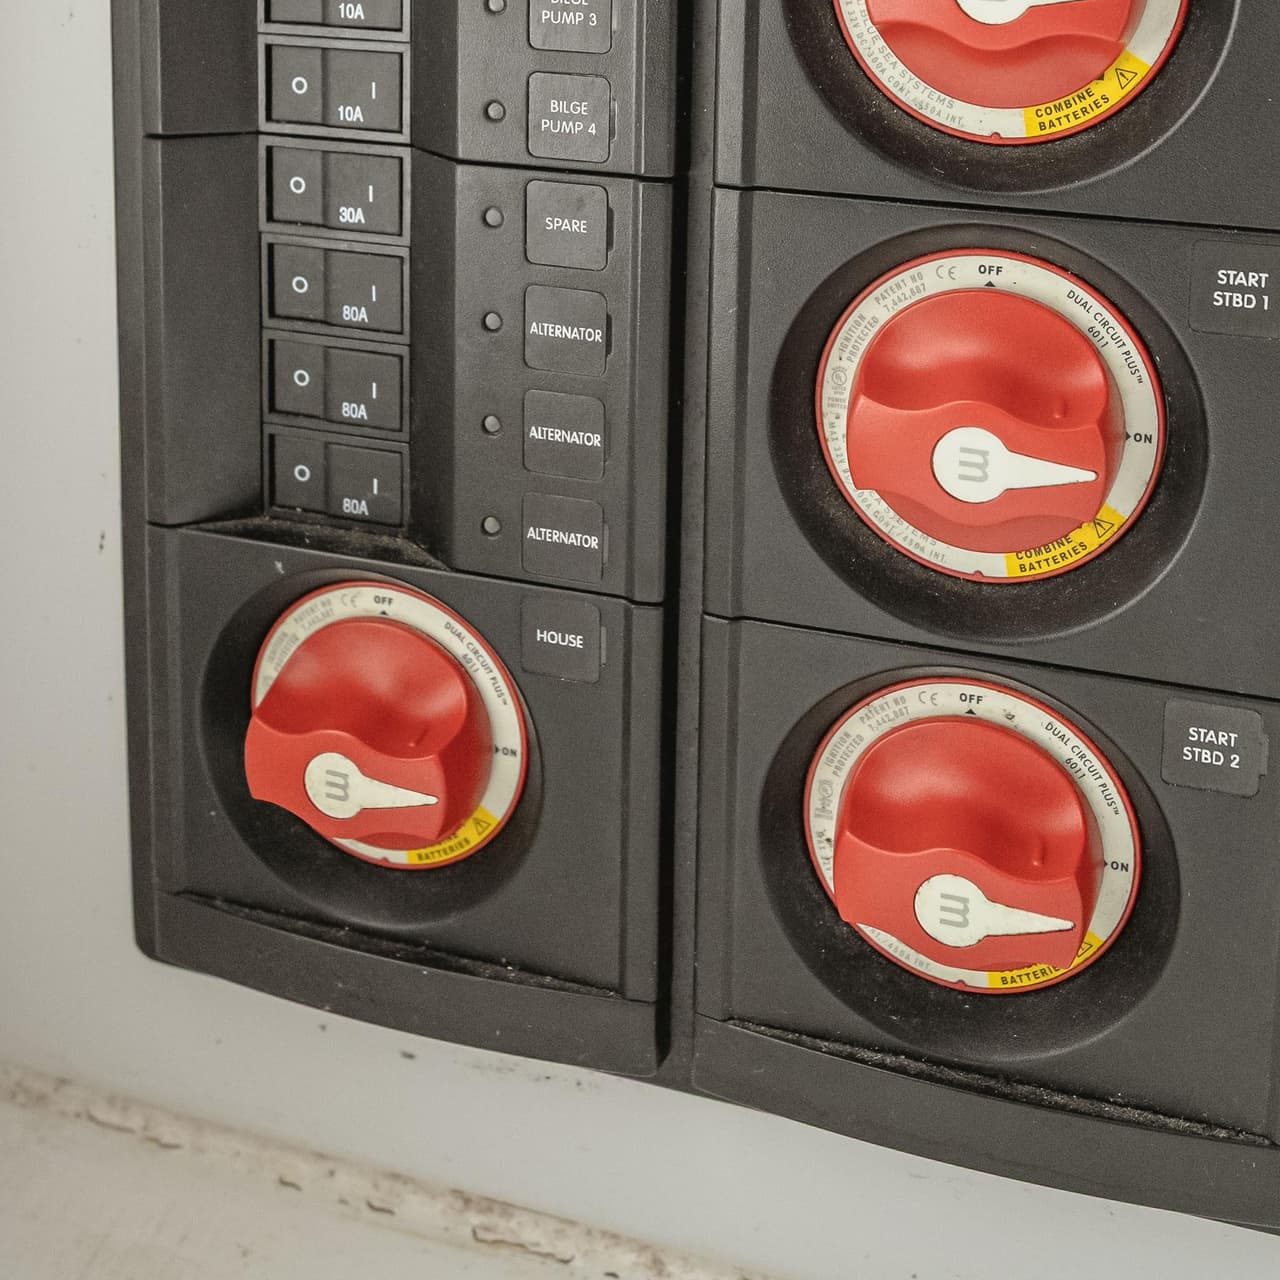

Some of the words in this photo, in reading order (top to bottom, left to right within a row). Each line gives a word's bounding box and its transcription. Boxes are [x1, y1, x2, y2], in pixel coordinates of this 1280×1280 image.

[338, 2, 365, 20] 10A
[541, 9, 584, 25] PUMP
[588, 12, 597, 26] 3
[898, 68, 956, 110] SYSTEMS
[550, 99, 589, 116] BILGE
[1034, 87, 1095, 119] COMBINE
[1037, 93, 1110, 132] BATTERIES
[337, 105, 364, 123] 10A
[541, 118, 584, 135] PUMP
[587, 122, 597, 136] 4
[339, 206, 366, 224] 30A
[545, 216, 588, 234] SPARE
[978, 264, 1003, 277] OFF
[1217, 269, 1269, 289] START
[1213, 290, 1257, 309] STBD
[1262, 295, 1269, 311] 1
[342, 304, 369, 323] 80A
[1065, 289, 1094, 315] DUAL
[1093, 311, 1127, 350] CIRCUIT
[529, 321, 603, 343] ALTERNATOR
[1087, 325, 1110, 349] 6011
[341, 401, 368, 420] 80A
[529, 425, 601, 447] ALTERNATOR
[1133, 432, 1153, 445] ON
[342, 497, 369, 516] 80A
[526, 526, 599, 550] ALTERNATOR
[1015, 535, 1073, 561] COMBINE
[1018, 540, 1088, 573] BATTERIES
[373, 595, 394, 607] OFF
[443, 620, 467, 646] DUAL
[465, 641, 495, 675] CIRCUIT
[536, 628, 584, 649] HOUSE
[959, 693, 984, 705] OFF
[1188, 726, 1239, 748] START
[501, 745, 518, 759] ON
[1043, 720, 1072, 747] DUAL
[1070, 744, 1104, 783] CIRCUIT
[1182, 746, 1225, 766] STBD
[1230, 754, 1240, 769] 2
[1064, 757, 1087, 780] 6011
[1110, 860, 1130, 873] ON
[1000, 965, 1060, 985] BATTERIE
